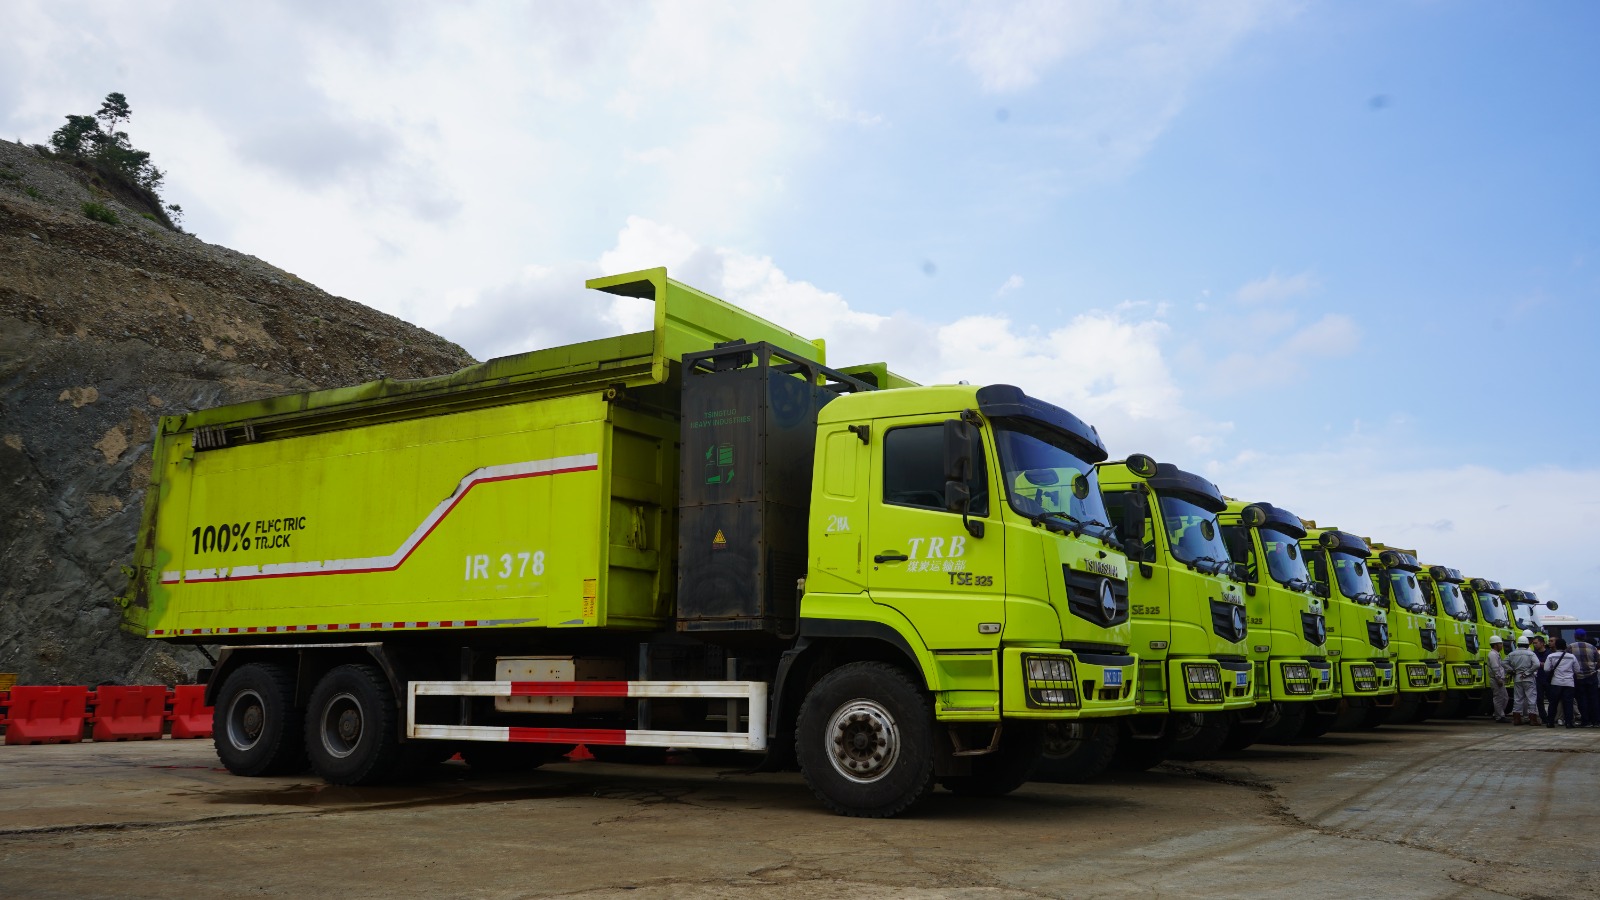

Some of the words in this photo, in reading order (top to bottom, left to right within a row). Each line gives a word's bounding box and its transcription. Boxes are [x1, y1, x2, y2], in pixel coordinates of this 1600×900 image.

[690, 420, 711, 429] HEAVY
[712, 415, 751, 426] INDUSTRIES
[704, 409, 737, 419] TSINGTUO
[192, 521, 251, 555] 100%
[908, 535, 966, 560] TRB
[464, 554, 489, 581] IR
[498, 550, 545, 579] 378
[948, 571, 973, 585] TSE
[974, 576, 993, 587] 325
[1131, 604, 1144, 615] SE
[1145, 606, 1160, 615] 325
